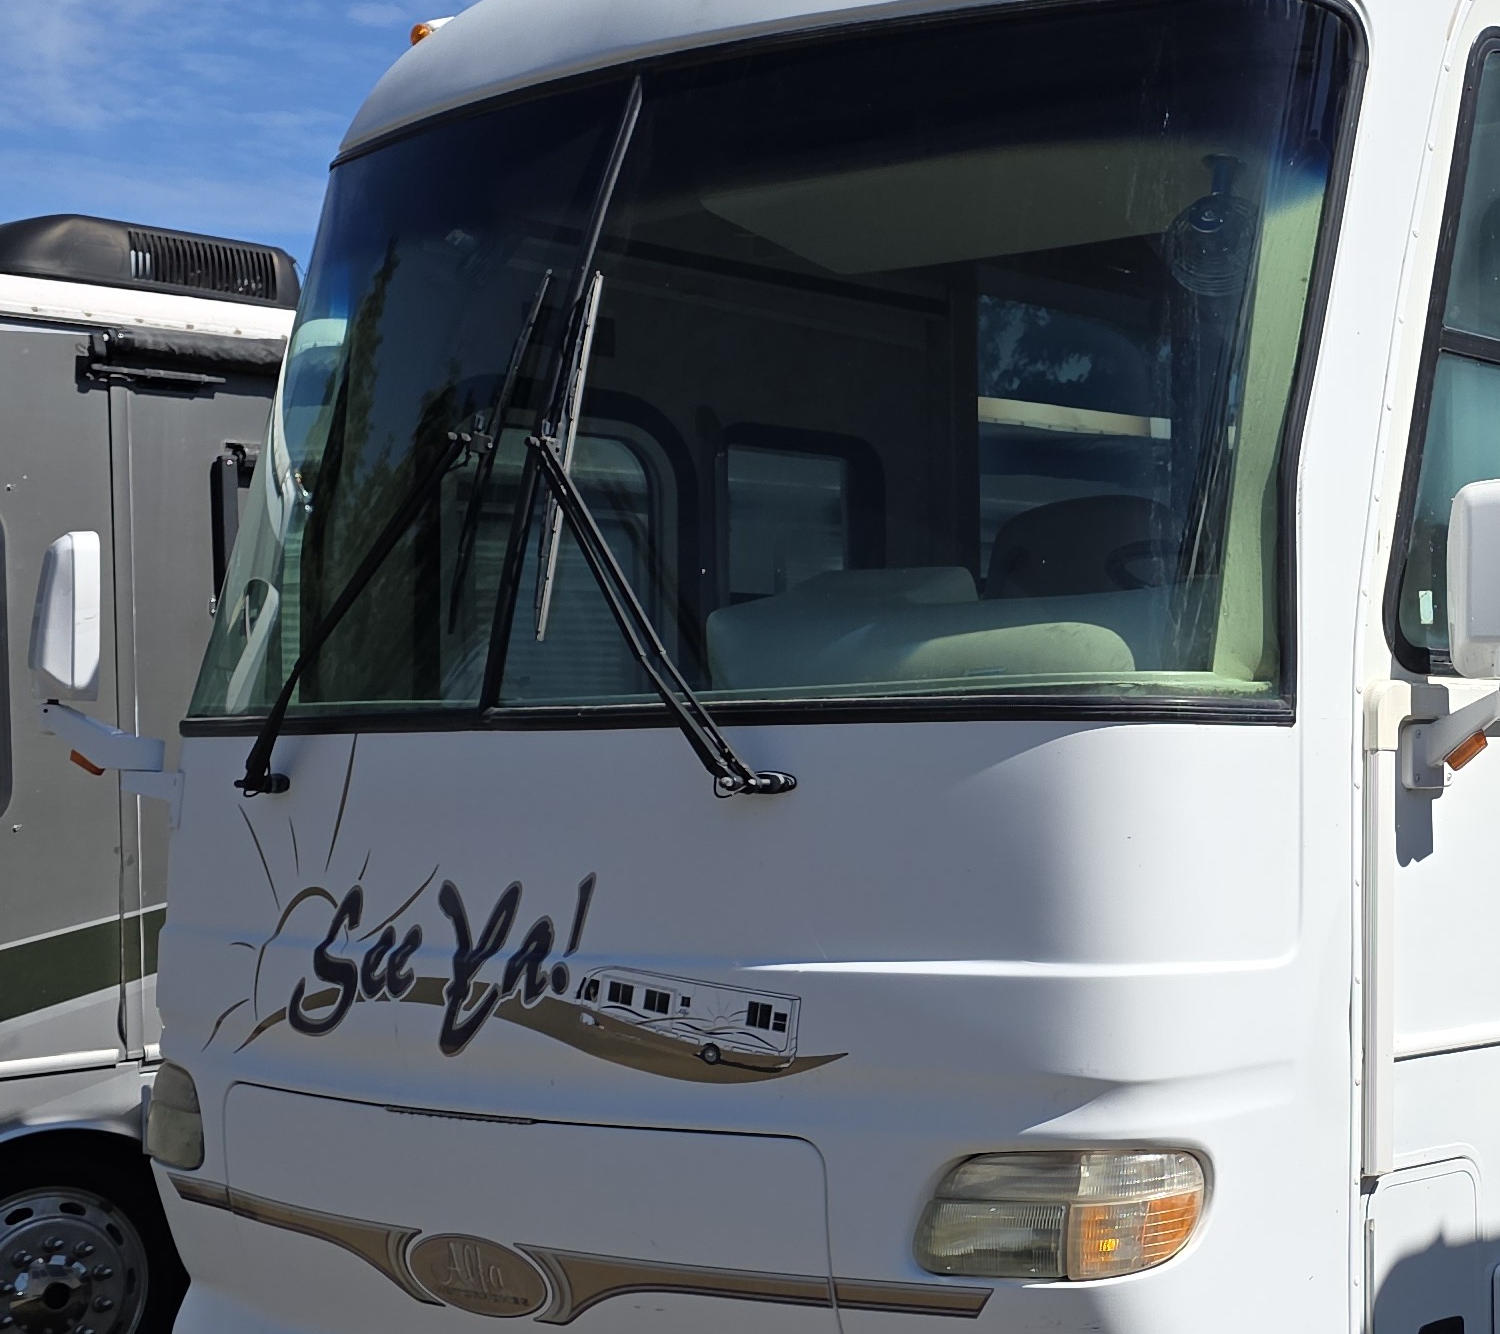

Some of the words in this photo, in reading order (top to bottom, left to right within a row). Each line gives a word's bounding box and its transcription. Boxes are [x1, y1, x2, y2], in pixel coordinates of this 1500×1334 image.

[288, 883, 423, 1038] See
[437, 871, 598, 1058] Ya!
[431, 1240, 506, 1294] Alfa
